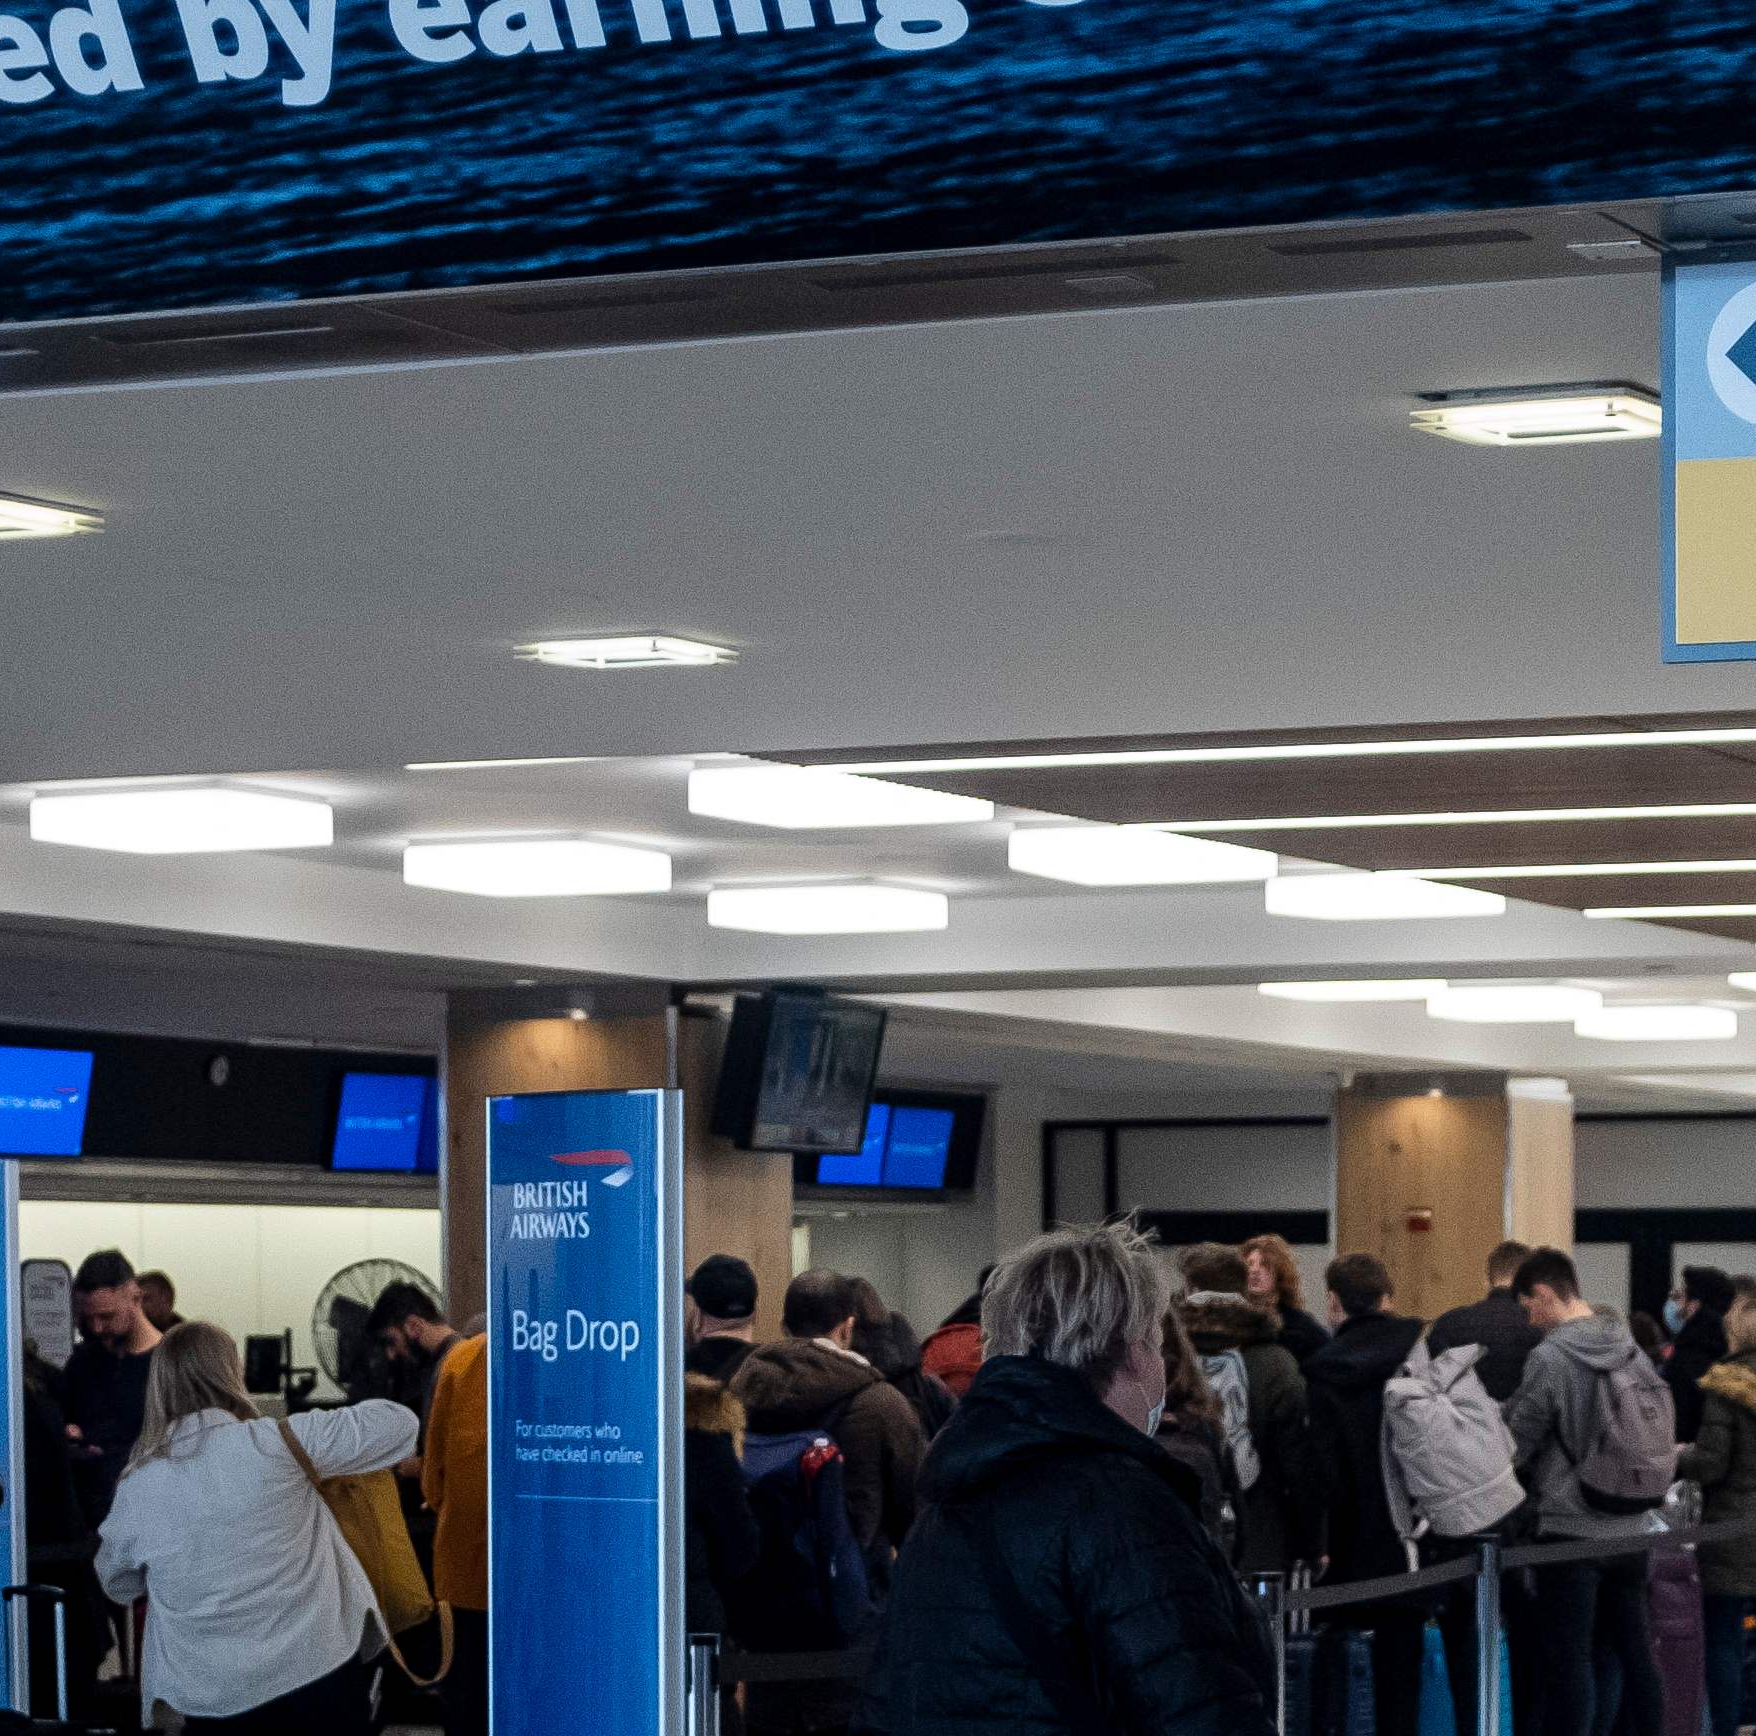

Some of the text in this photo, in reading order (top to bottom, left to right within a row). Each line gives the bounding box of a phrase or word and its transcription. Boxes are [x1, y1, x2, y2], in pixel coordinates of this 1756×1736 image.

[175, 0, 338, 107] by
[513, 1180, 587, 1209] BRITISH
[510, 1211, 591, 1239] AIRWAYS
[512, 1308, 641, 1362] Bag Drop
[515, 1419, 622, 1440] For customers who
[515, 1443, 644, 1464] have checked in online
